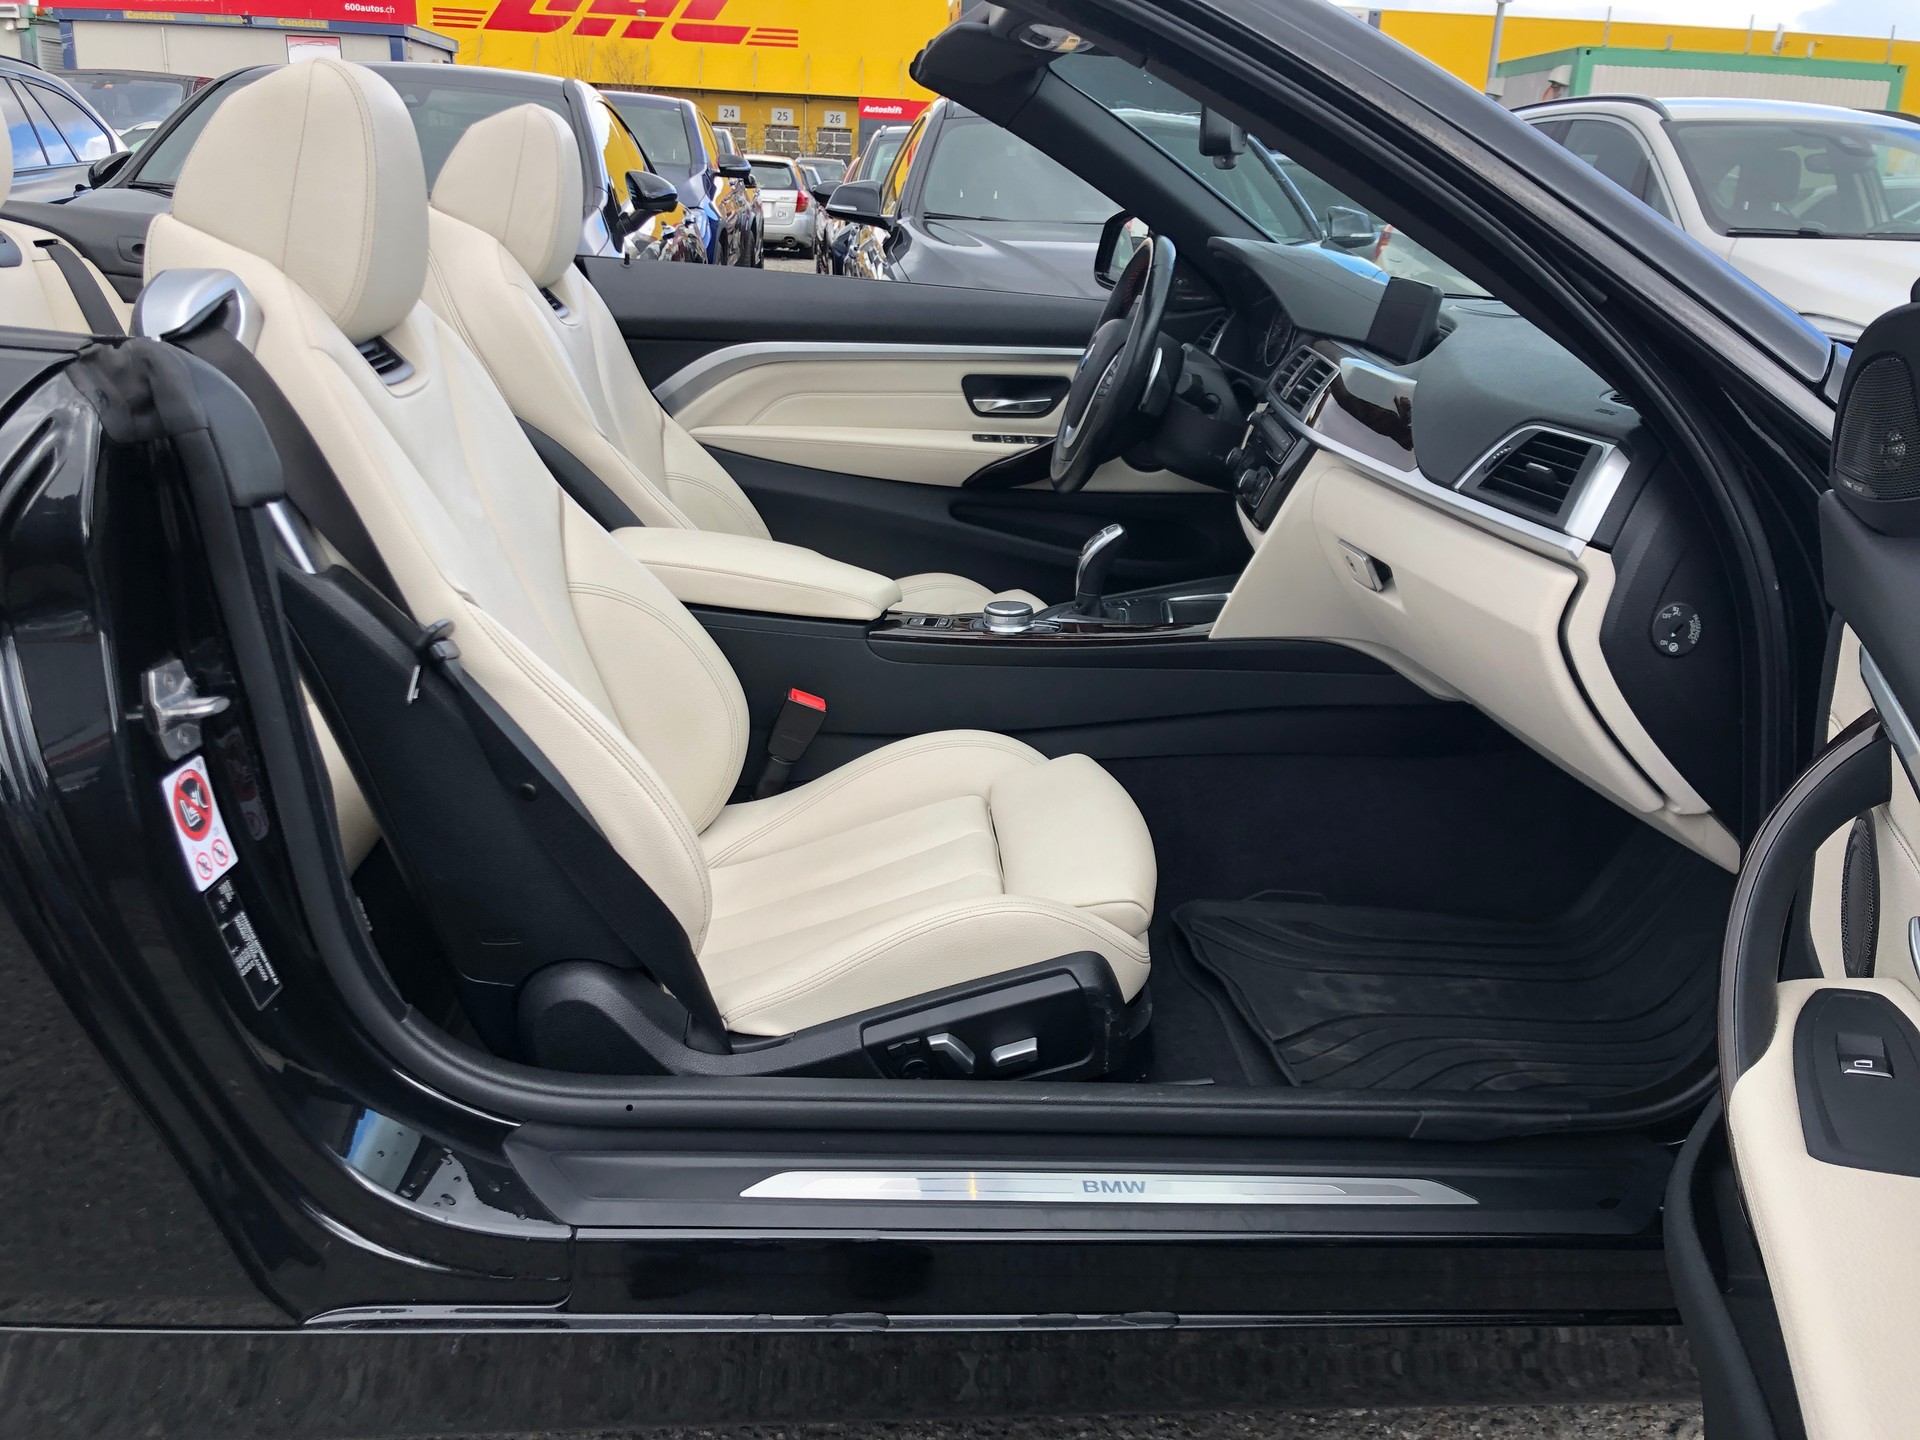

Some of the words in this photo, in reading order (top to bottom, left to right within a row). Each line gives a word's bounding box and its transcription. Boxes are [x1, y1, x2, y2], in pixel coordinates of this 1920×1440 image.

[344, 3, 396, 14] 600autos.ch
[126, 10, 175, 21] Condecta
[277, 18, 327, 28] Condecta
[723, 108, 735, 119] 24
[863, 105, 903, 115] Autoshift
[776, 111, 789, 121] 25
[829, 114, 841, 124] 26
[777, 210, 787, 218] CH
[1082, 1180, 1146, 1193] BMW
